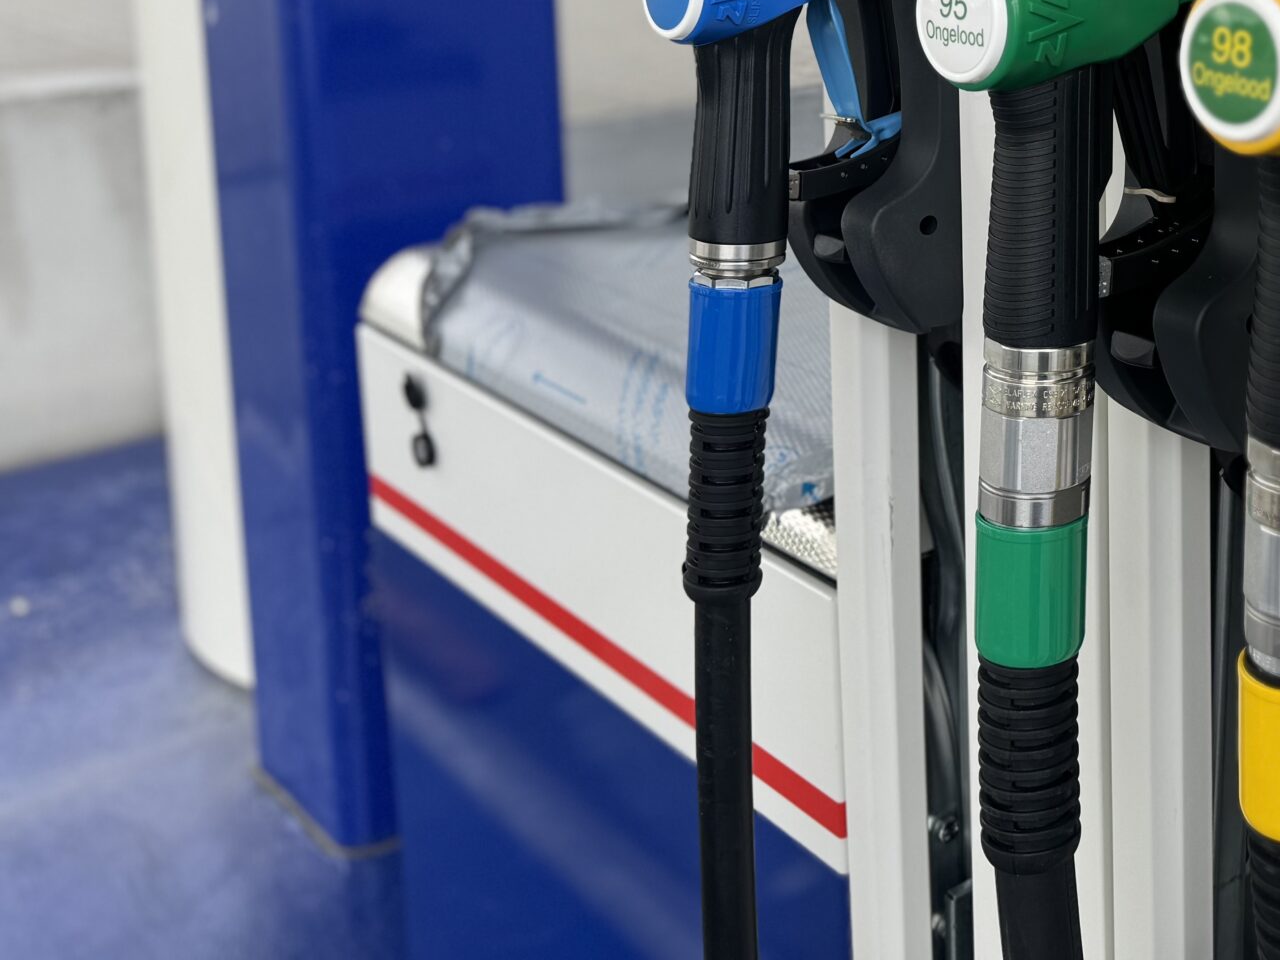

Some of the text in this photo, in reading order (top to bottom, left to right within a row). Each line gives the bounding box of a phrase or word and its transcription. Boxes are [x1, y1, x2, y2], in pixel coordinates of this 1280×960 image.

[925, 19, 985, 48] Ongelood
[1210, 25, 1253, 69] 98
[1191, 61, 1272, 102] Ongelood
